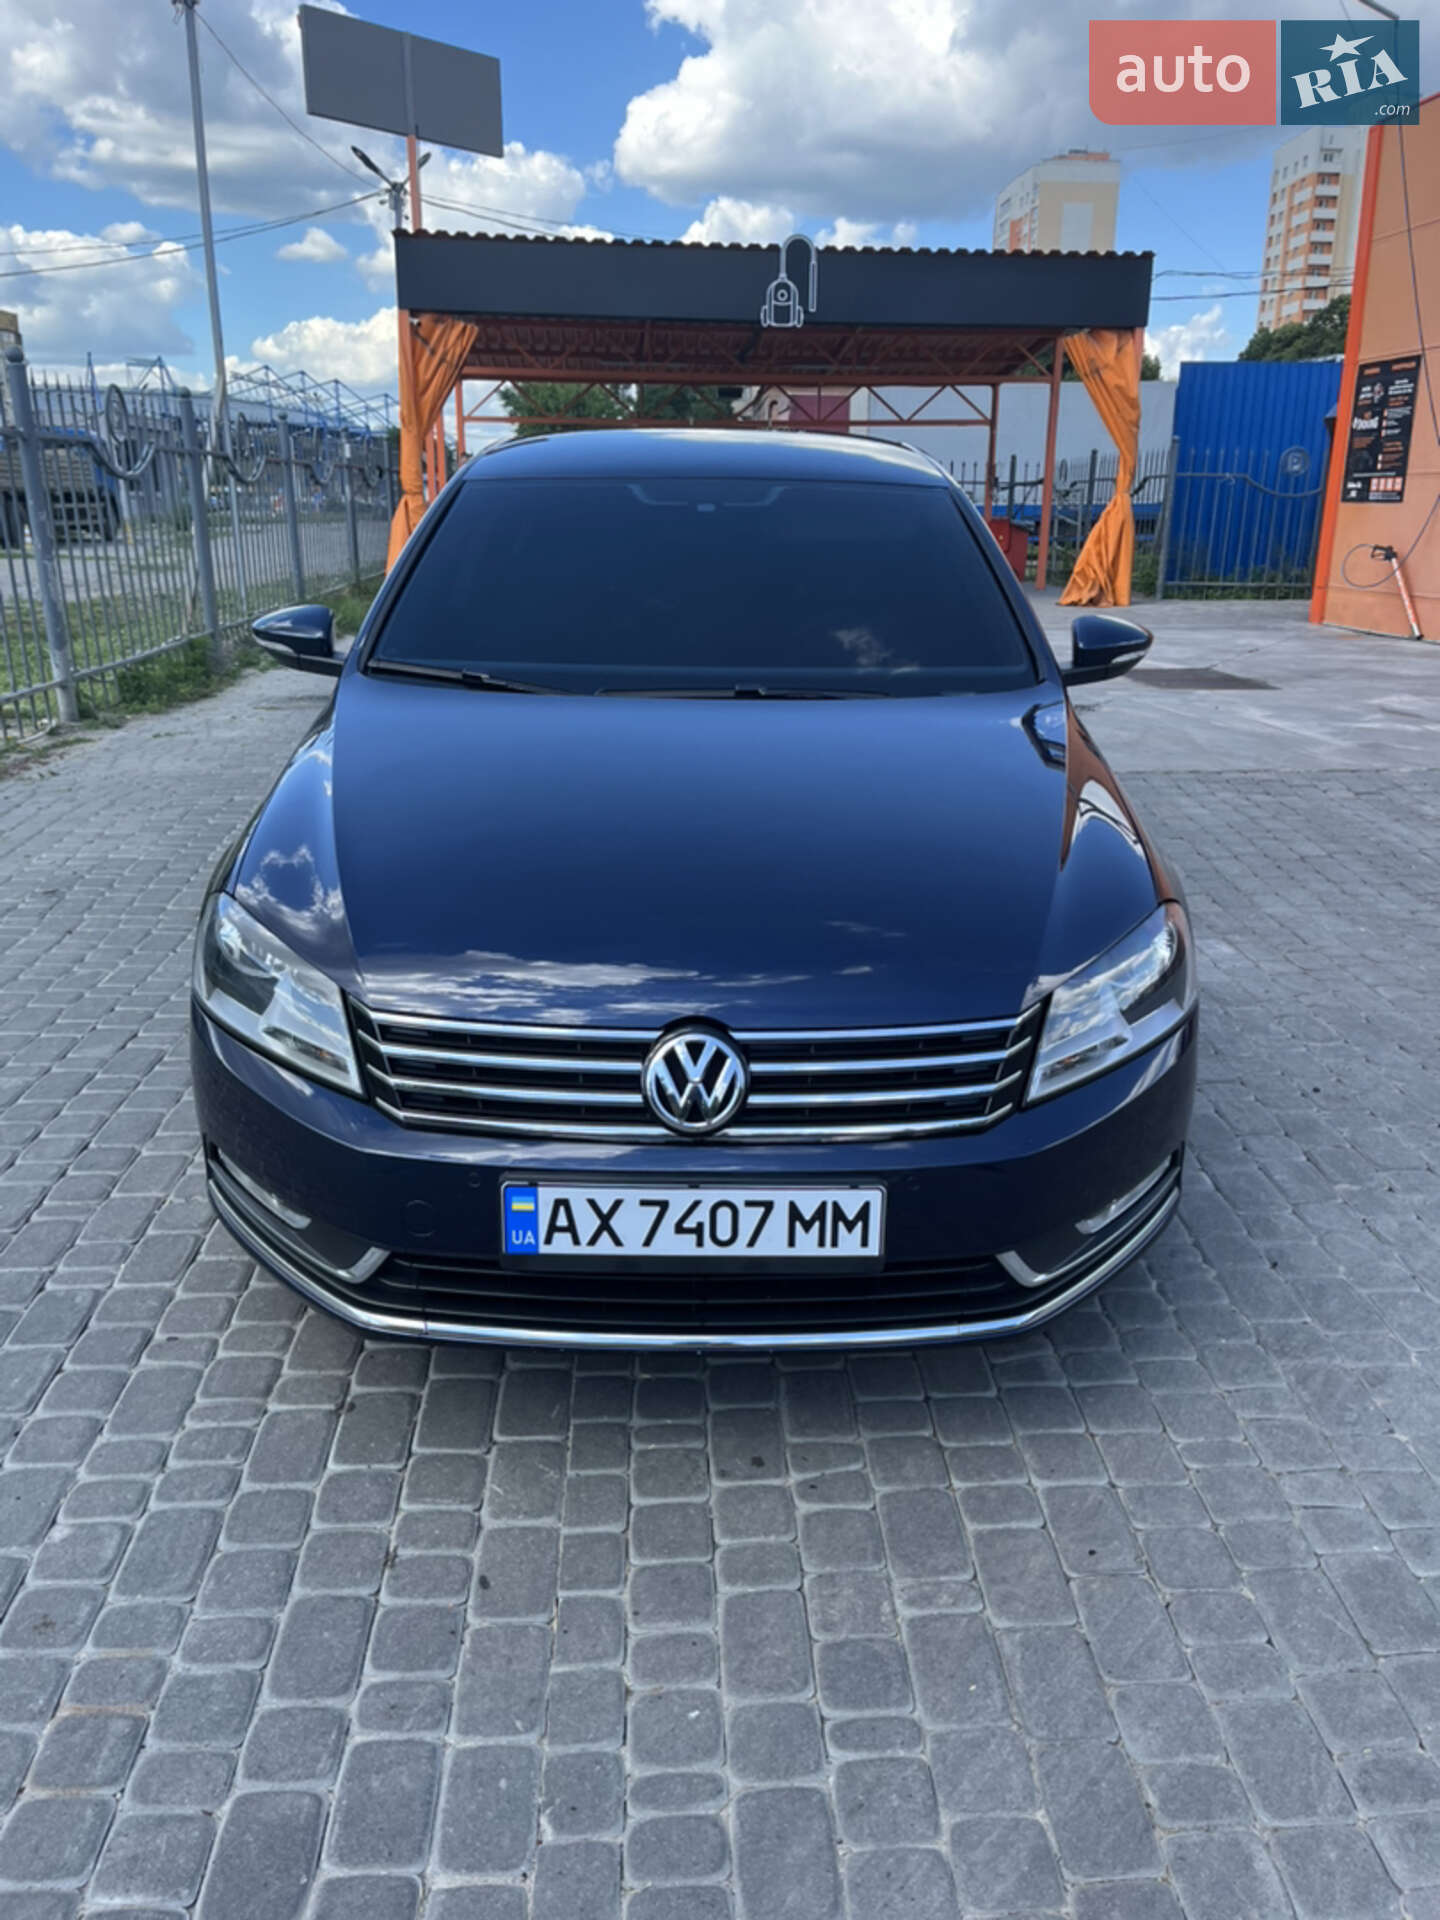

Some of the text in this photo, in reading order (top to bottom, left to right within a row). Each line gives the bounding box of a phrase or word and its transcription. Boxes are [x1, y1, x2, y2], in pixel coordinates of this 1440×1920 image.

[511, 1230, 536, 1245] UA
[543, 1198, 871, 1249] AX 7407 MM
